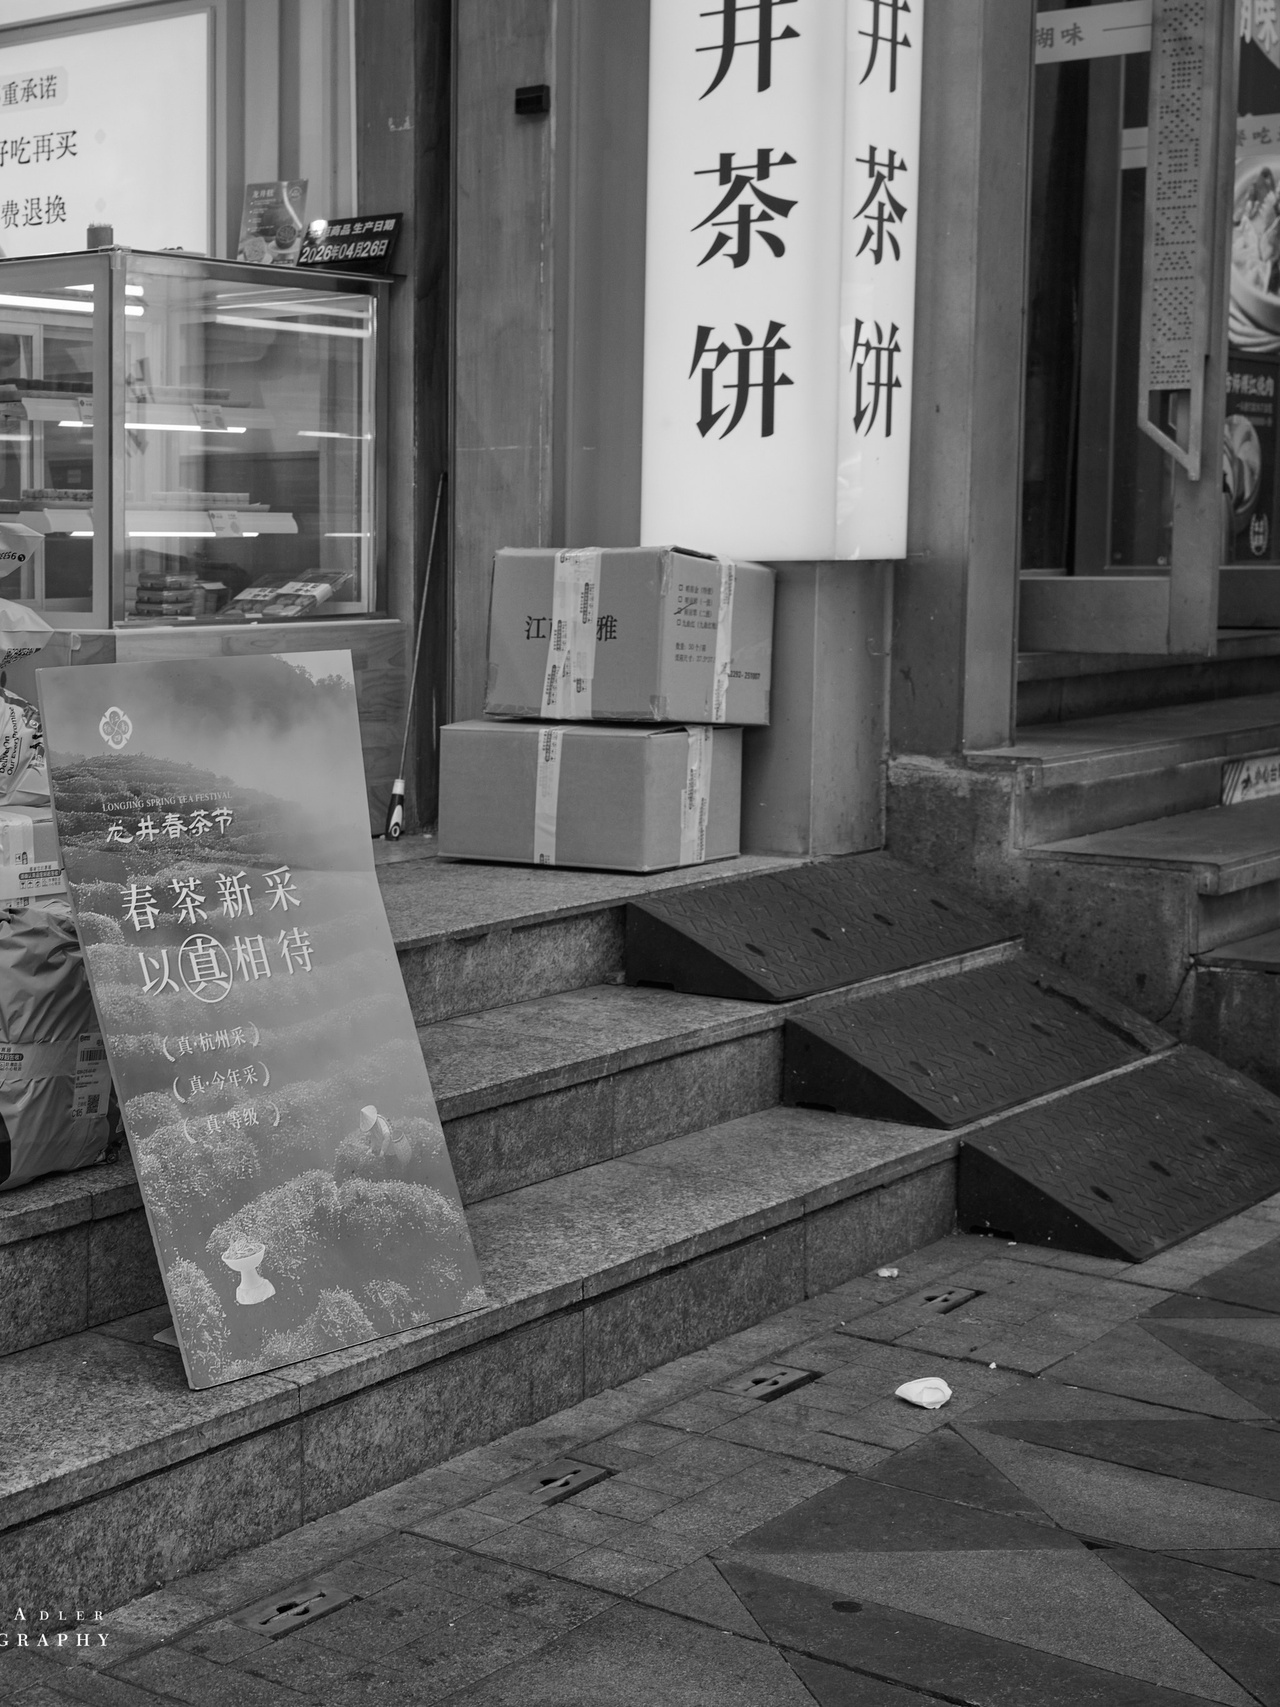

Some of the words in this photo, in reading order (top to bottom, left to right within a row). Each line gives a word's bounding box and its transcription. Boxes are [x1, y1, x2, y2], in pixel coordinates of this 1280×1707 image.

[352, 219, 396, 234] 生产日期
[299, 239, 389, 263] 2026年04月26日
[525, 614, 618, 642] 江雅
[6, 759, 15, 776] Our
[102, 799, 144, 812] LONGJING
[147, 796, 176, 808] SPRING
[178, 794, 194, 804] TEA
[195, 791, 233, 802] FESTIVAL
[106, 806, 234, 843] 龙井春茶节
[121, 865, 301, 933] 春茶新采
[139, 927, 315, 999] 以真相待
